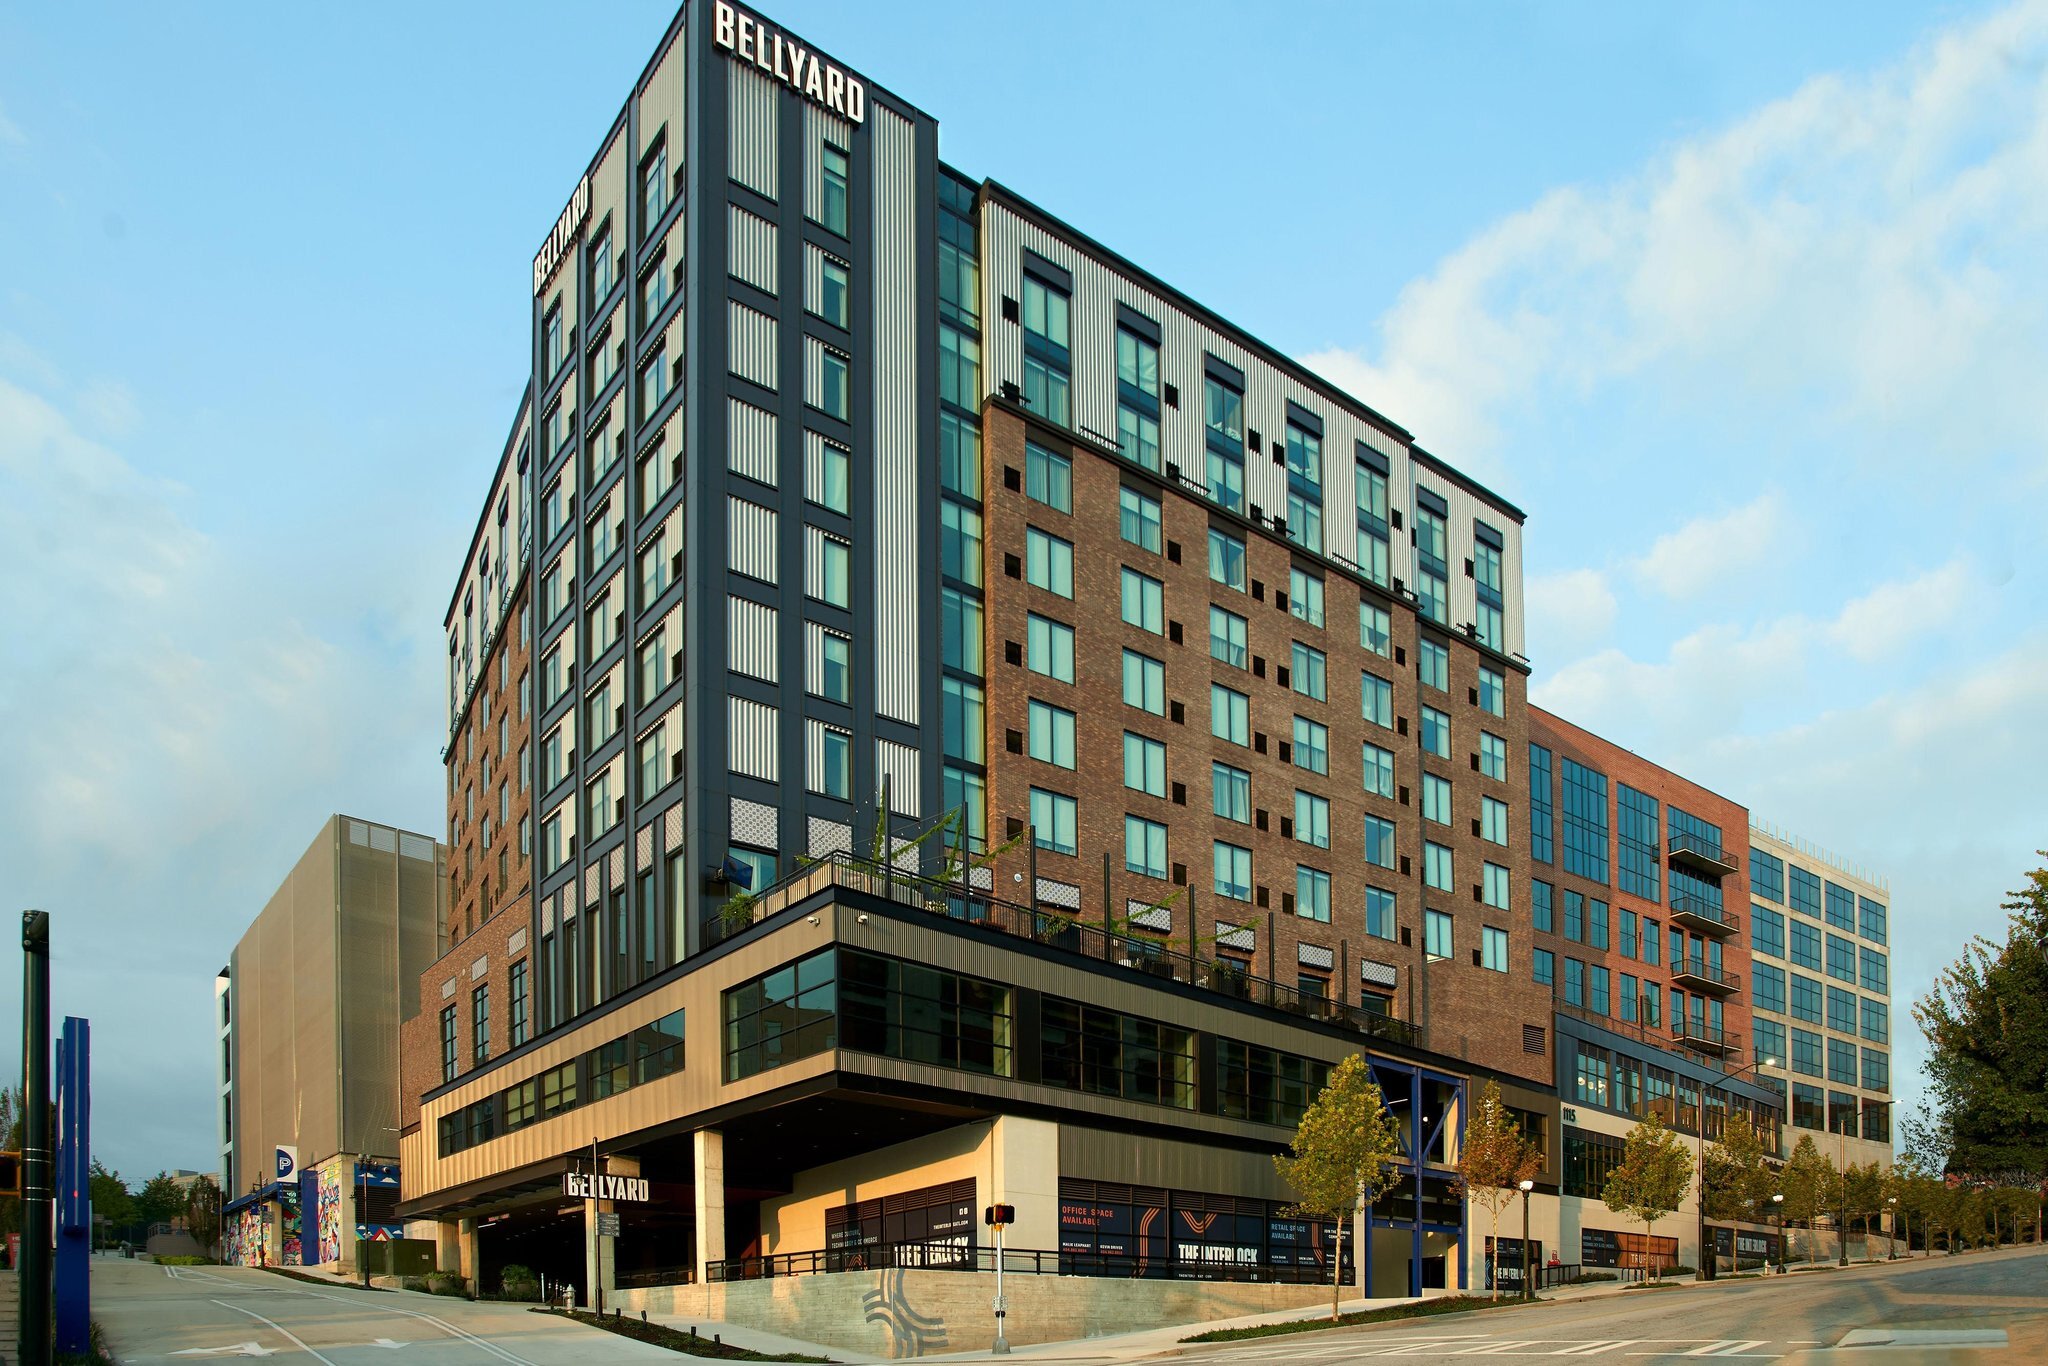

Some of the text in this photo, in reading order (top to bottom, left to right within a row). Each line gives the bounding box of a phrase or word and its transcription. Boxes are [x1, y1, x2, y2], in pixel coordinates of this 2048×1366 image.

[714, 0, 864, 124] BELLYARD
[534, 174, 588, 297] BELLYARD
[1563, 1106, 1577, 1122] 1115
[280, 1157, 291, 1170] P
[1062, 1206, 1087, 1216] OFFICE
[1178, 1244, 1199, 1264] THE
